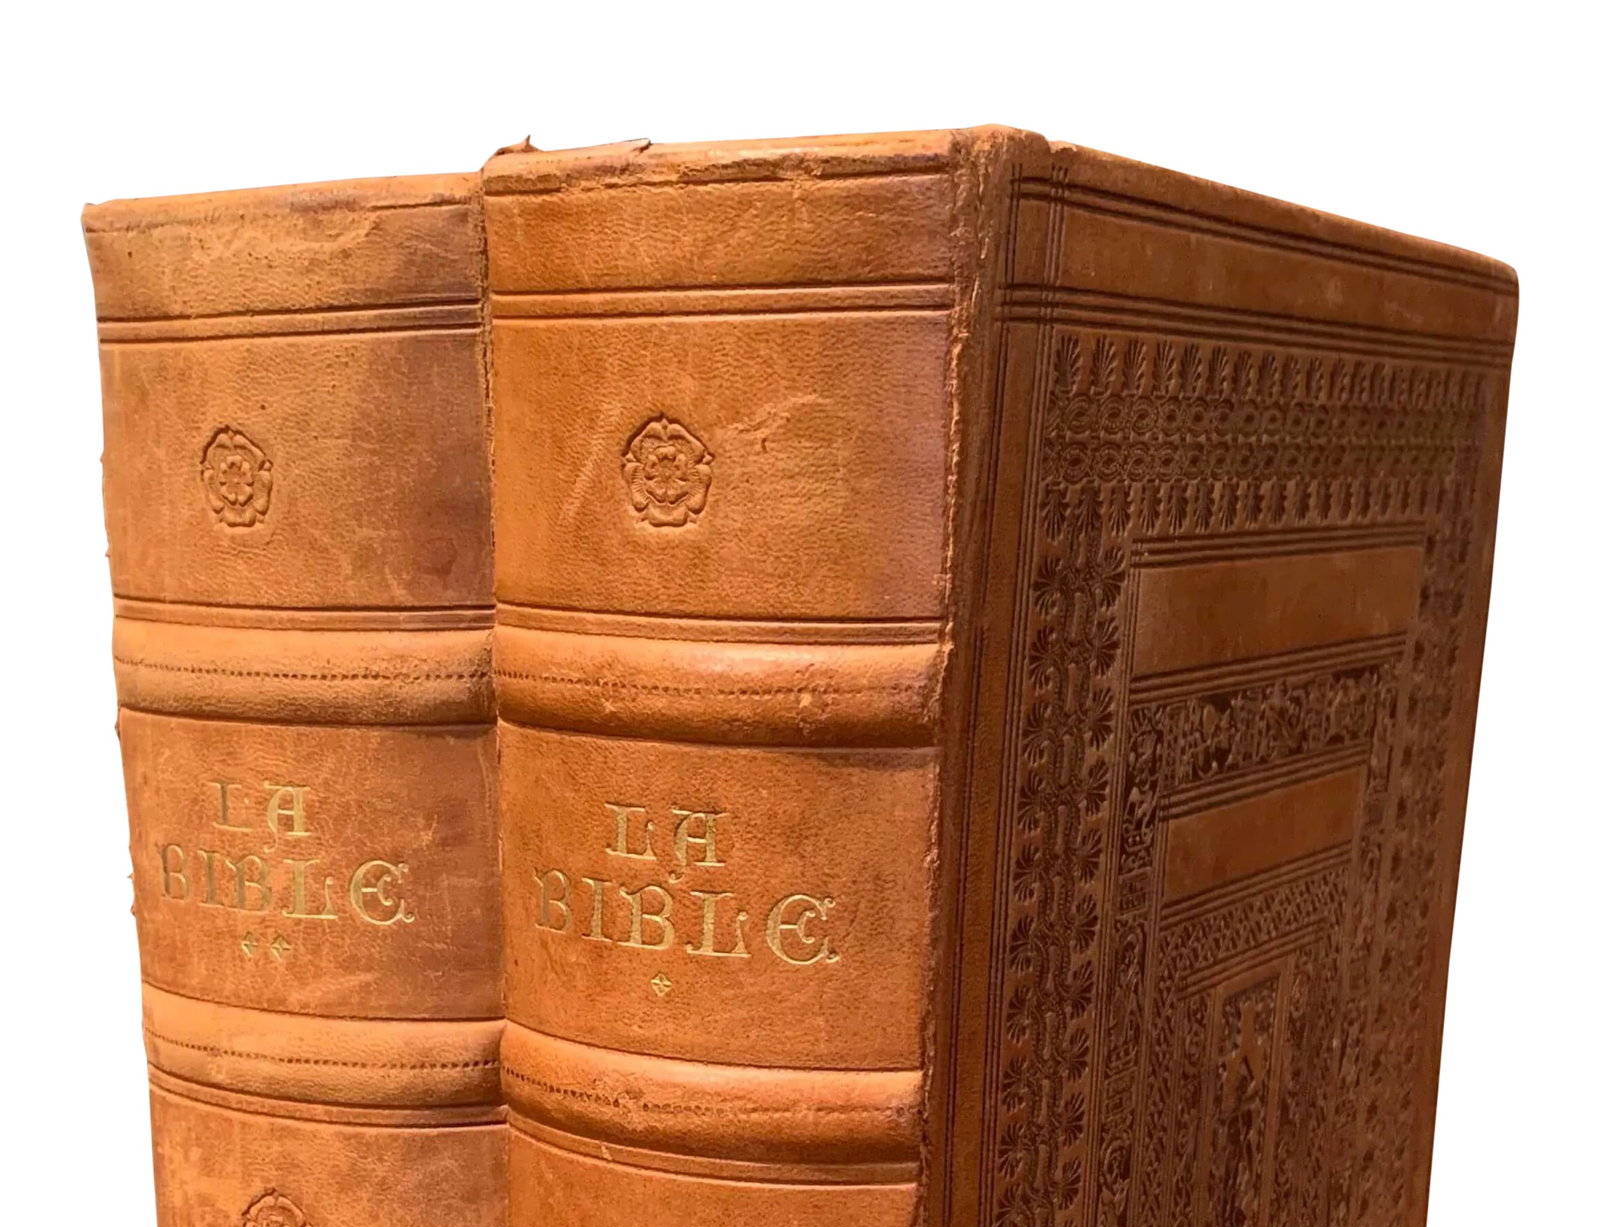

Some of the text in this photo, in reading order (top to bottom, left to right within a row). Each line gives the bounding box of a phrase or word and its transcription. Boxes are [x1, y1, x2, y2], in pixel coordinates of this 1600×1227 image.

[207, 780, 313, 854] LA
[604, 802, 731, 884] LA
[154, 842, 416, 926] BIBLE
[533, 867, 841, 966] BIBLE
